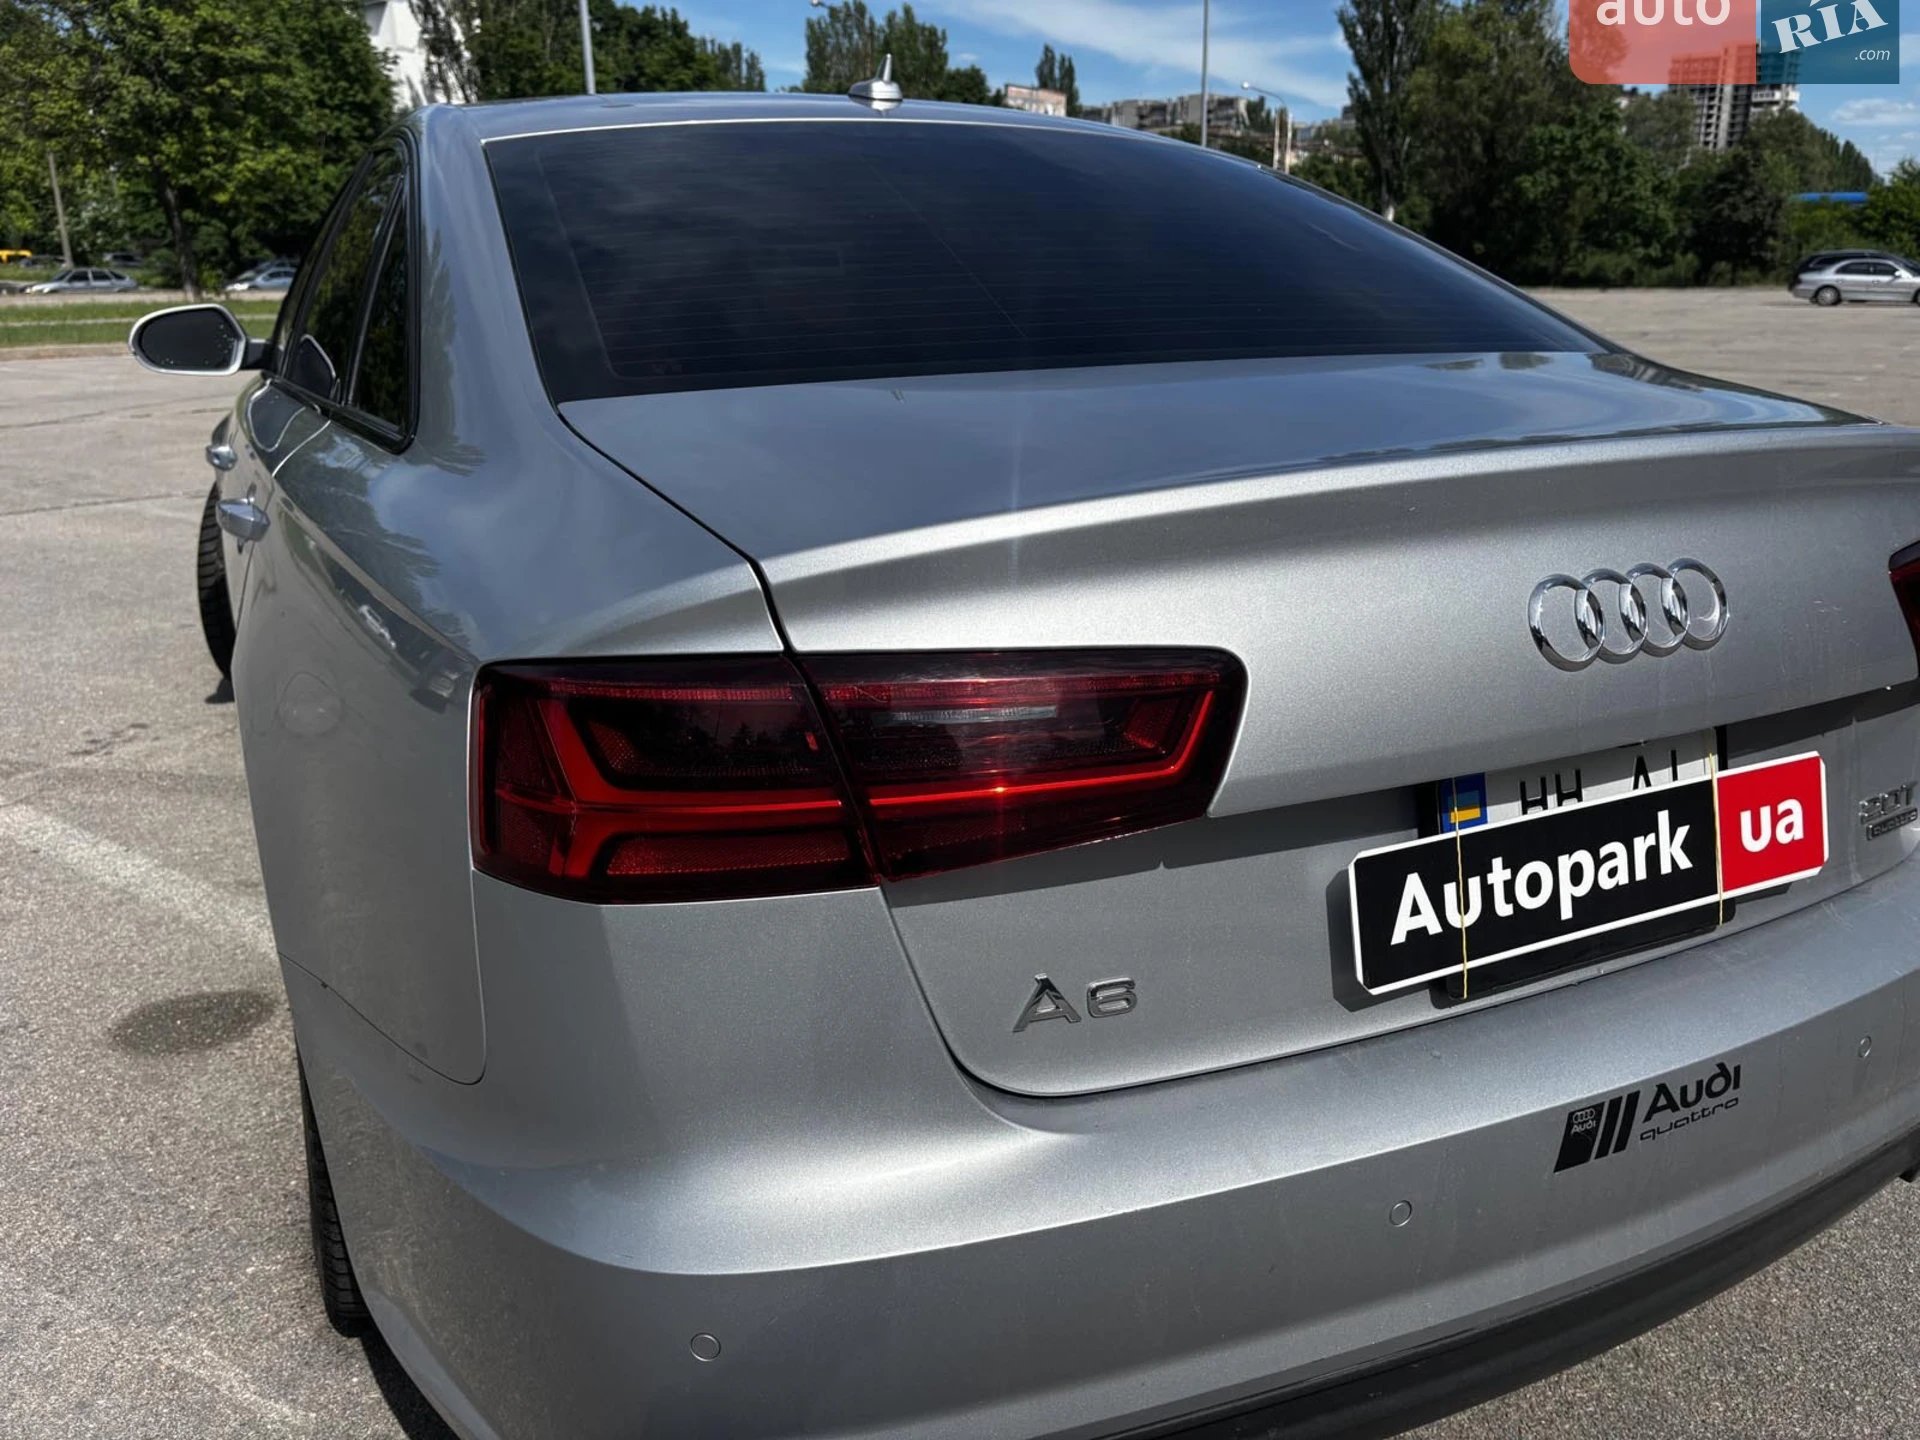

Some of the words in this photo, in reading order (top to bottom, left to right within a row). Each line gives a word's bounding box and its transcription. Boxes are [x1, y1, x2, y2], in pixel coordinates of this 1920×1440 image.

[1390, 809, 1694, 946] Autopark
[1740, 798, 1804, 853] ua
[1012, 972, 1138, 1033] A6
[1639, 1097, 1739, 1141] quattro
[1642, 1062, 1741, 1124] Audi
